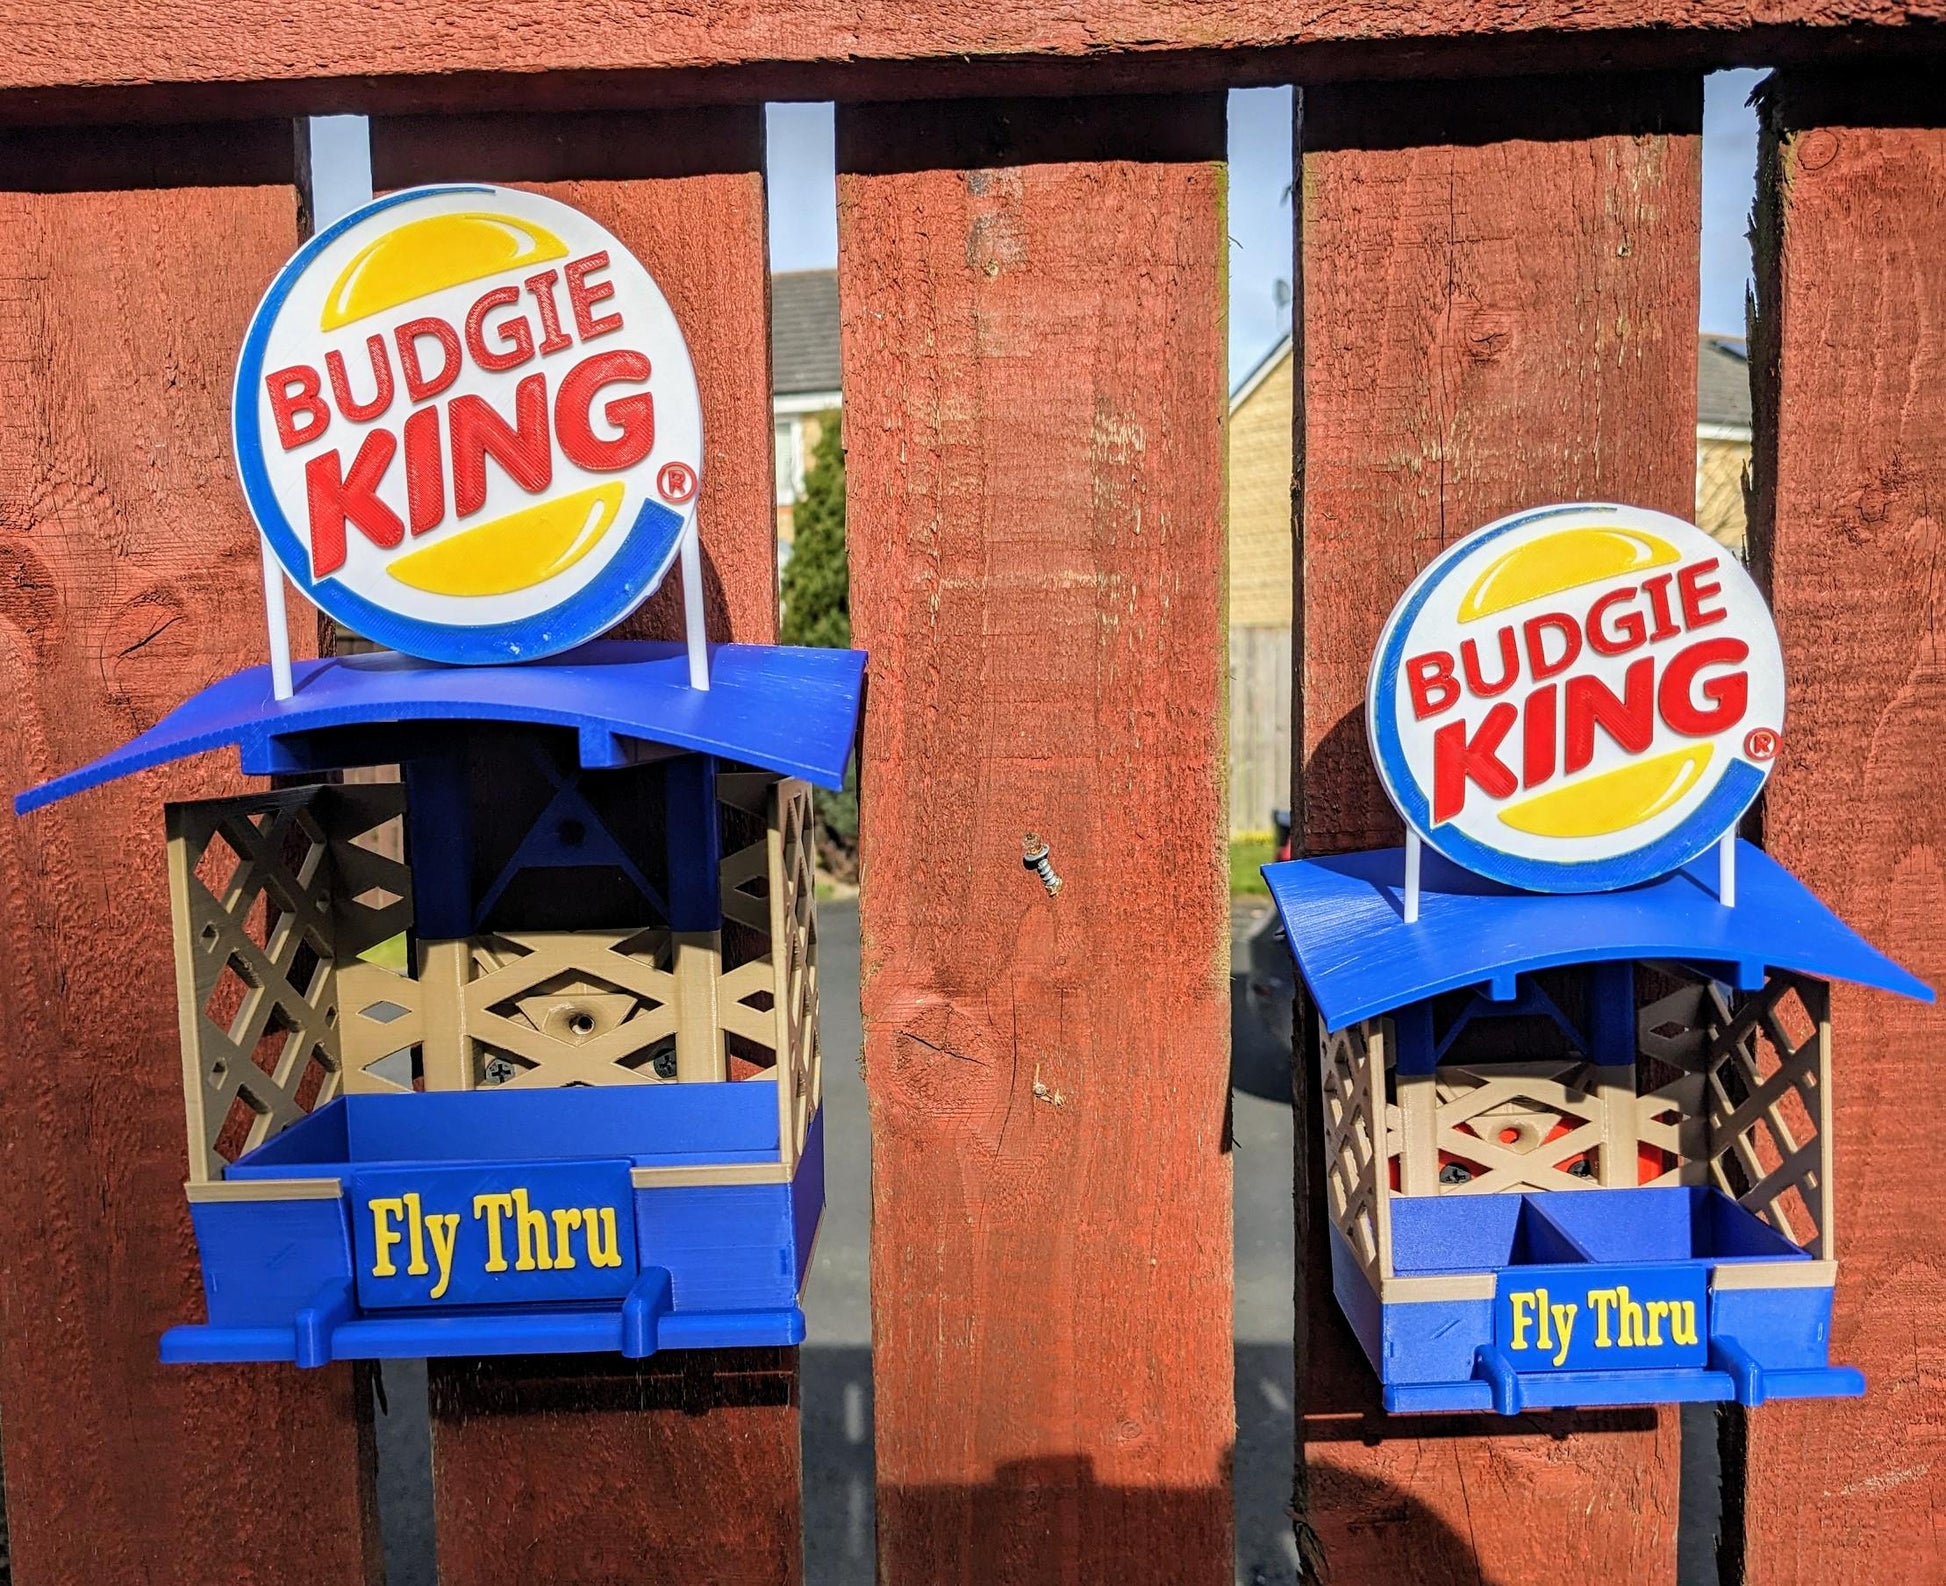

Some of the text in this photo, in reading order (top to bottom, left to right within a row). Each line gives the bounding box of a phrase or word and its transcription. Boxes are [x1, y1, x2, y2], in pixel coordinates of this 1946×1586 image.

[265, 250, 624, 450] BUDGIE
[305, 349, 656, 578] KING
[1406, 557, 1728, 720] BUDGIE
[1433, 637, 1750, 823] KING
[368, 1188, 622, 1299] Fly Thru
[1509, 1286, 1699, 1367] Fly Thru
